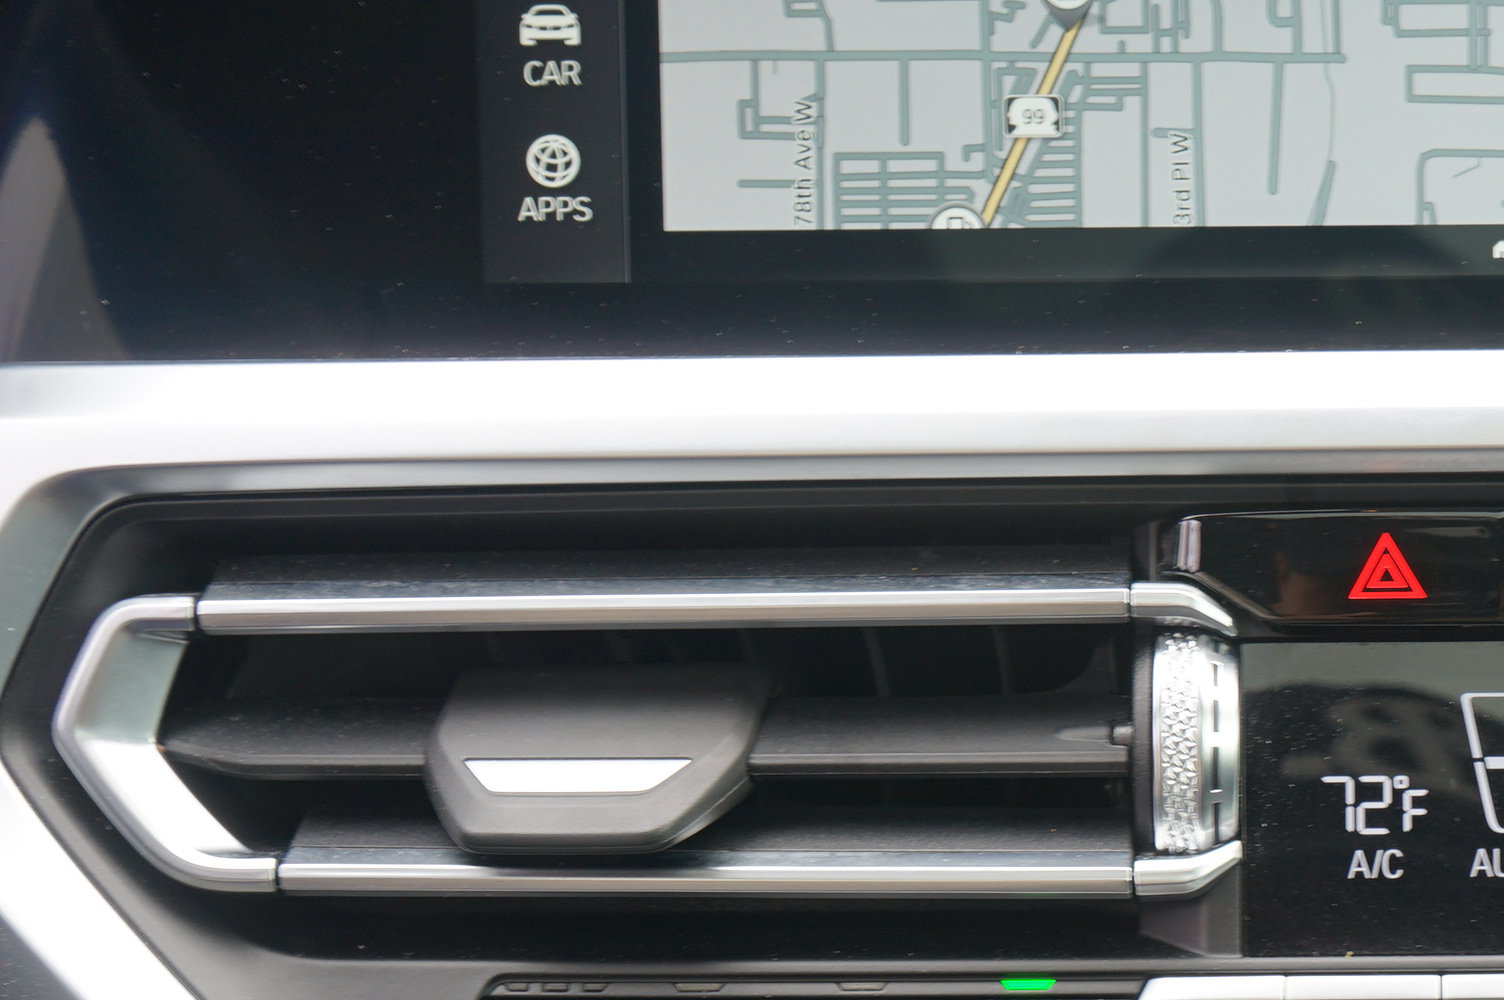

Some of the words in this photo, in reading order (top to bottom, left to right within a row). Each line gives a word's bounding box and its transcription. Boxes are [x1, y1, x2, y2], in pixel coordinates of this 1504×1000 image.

[523, 60, 582, 87] CAR
[793, 100, 812, 122] W
[1022, 108, 1044, 125] 99
[793, 129, 812, 170] Ave
[1170, 131, 1189, 154] W
[1171, 162, 1190, 180] Pl
[518, 196, 594, 222] APPS
[793, 178, 812, 226] 78th
[1347, 848, 1405, 879] A/C
